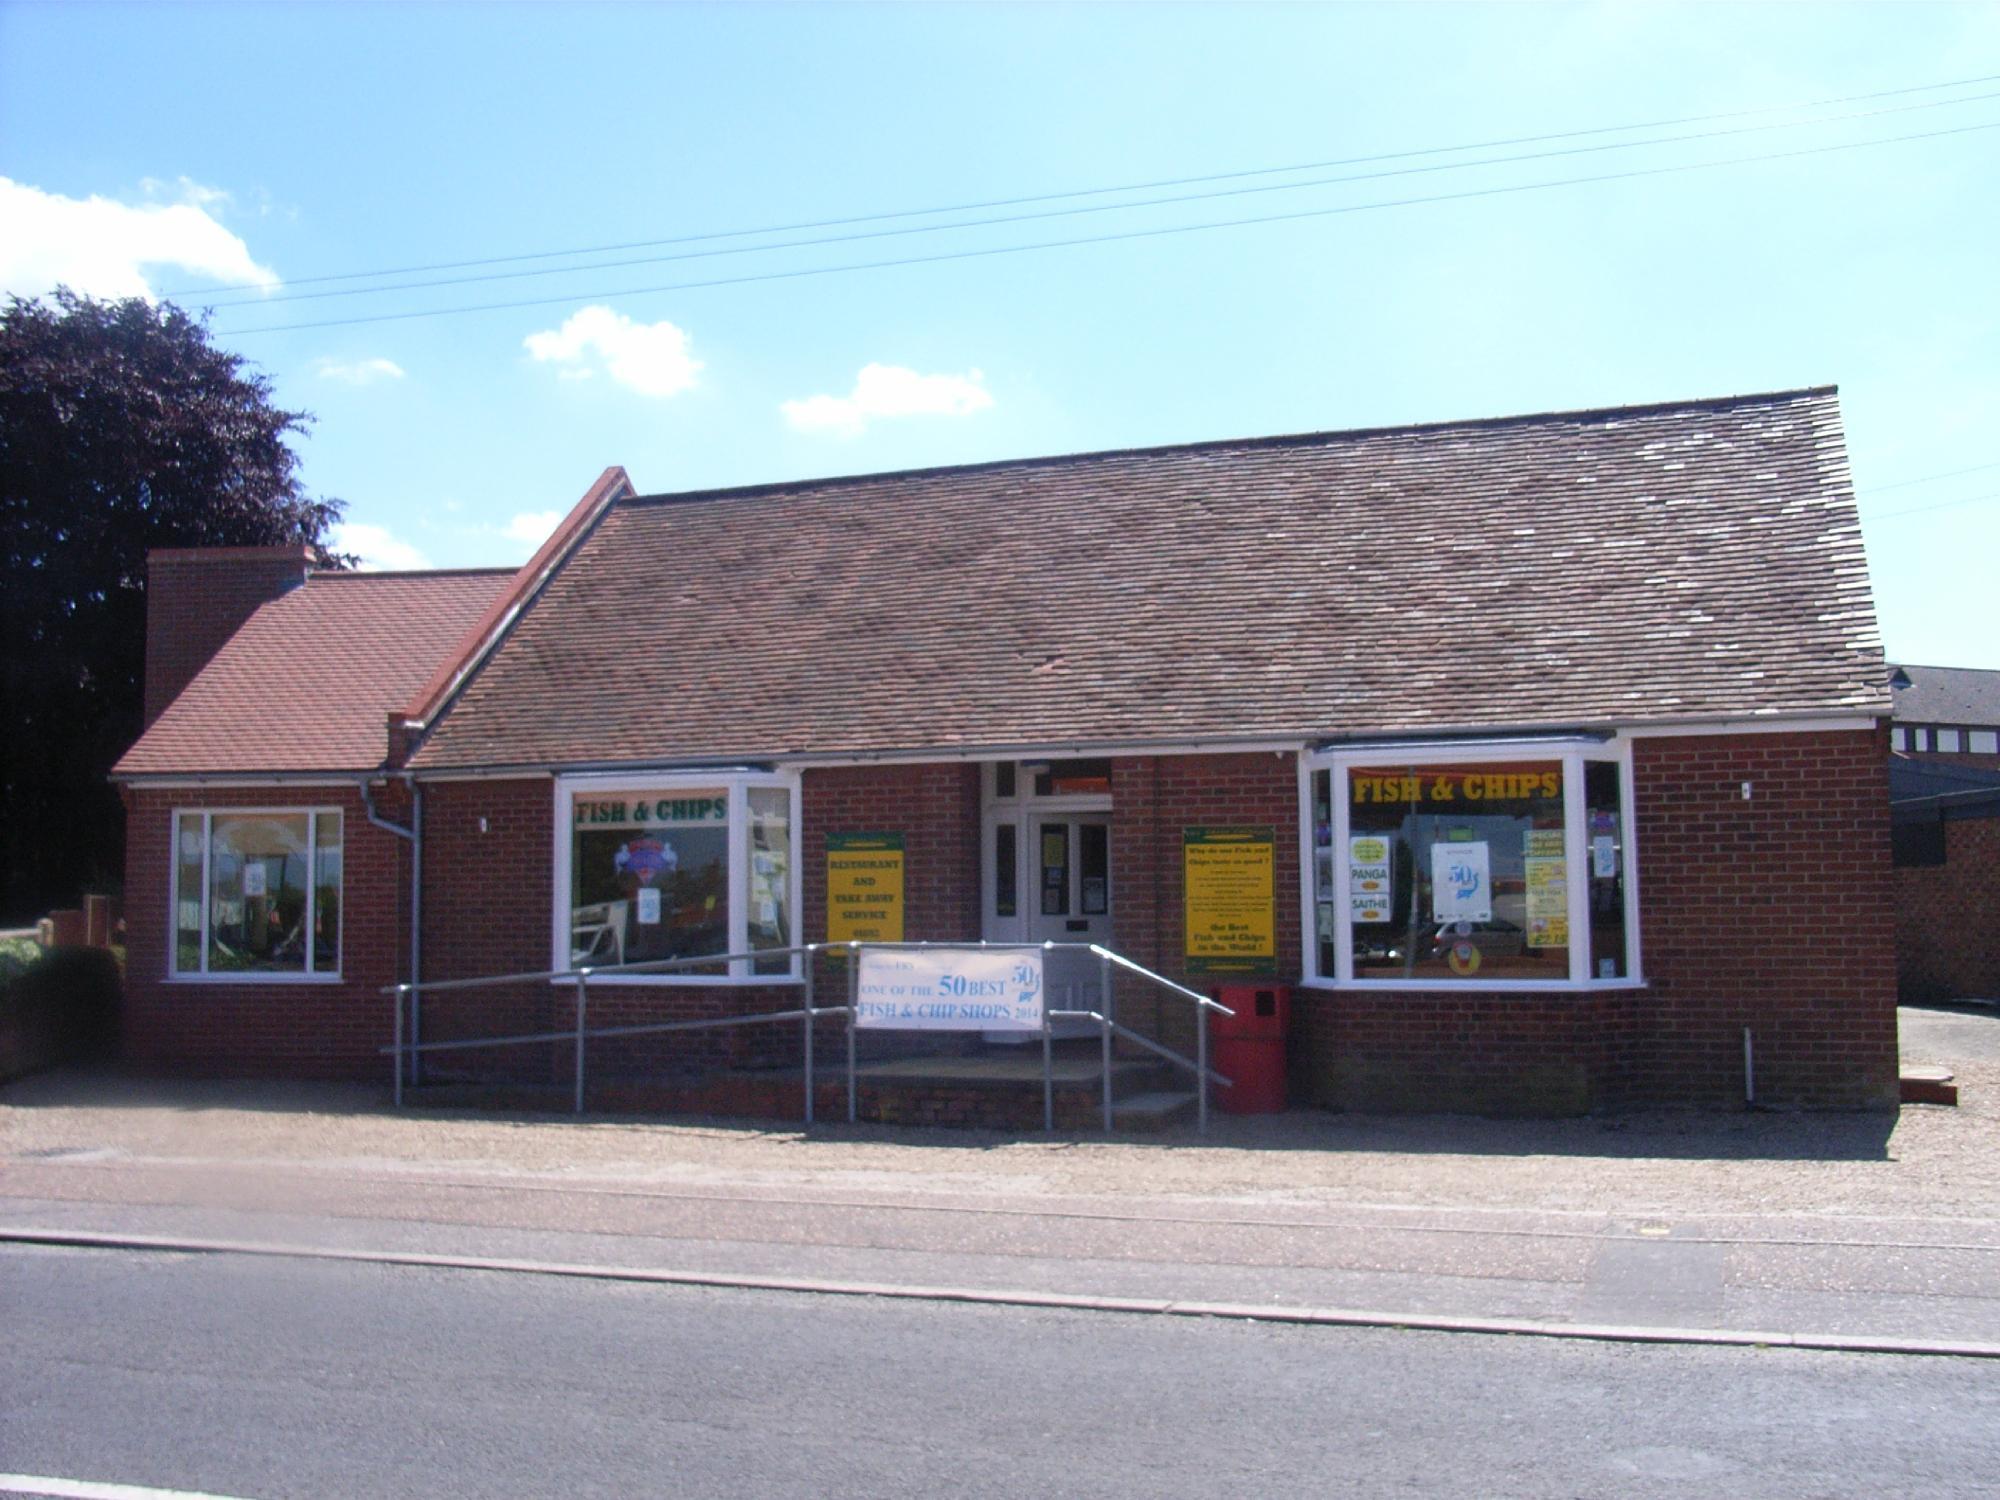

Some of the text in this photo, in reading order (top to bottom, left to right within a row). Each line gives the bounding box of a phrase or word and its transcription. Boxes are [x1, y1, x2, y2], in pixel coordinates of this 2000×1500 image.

[1354, 772, 1557, 803] FISH & CHIPS
[576, 798, 728, 823] FISH & CHIPS
[1351, 868, 1387, 880] PANGA
[853, 877, 876, 887] AND
[1351, 898, 1388, 910] SAITHE
[842, 911, 887, 920] SERVICE
[861, 975, 1006, 997] ONE OF THE 50 BEST
[860, 1002, 1010, 1018] FISH & CHIP SHOPS
